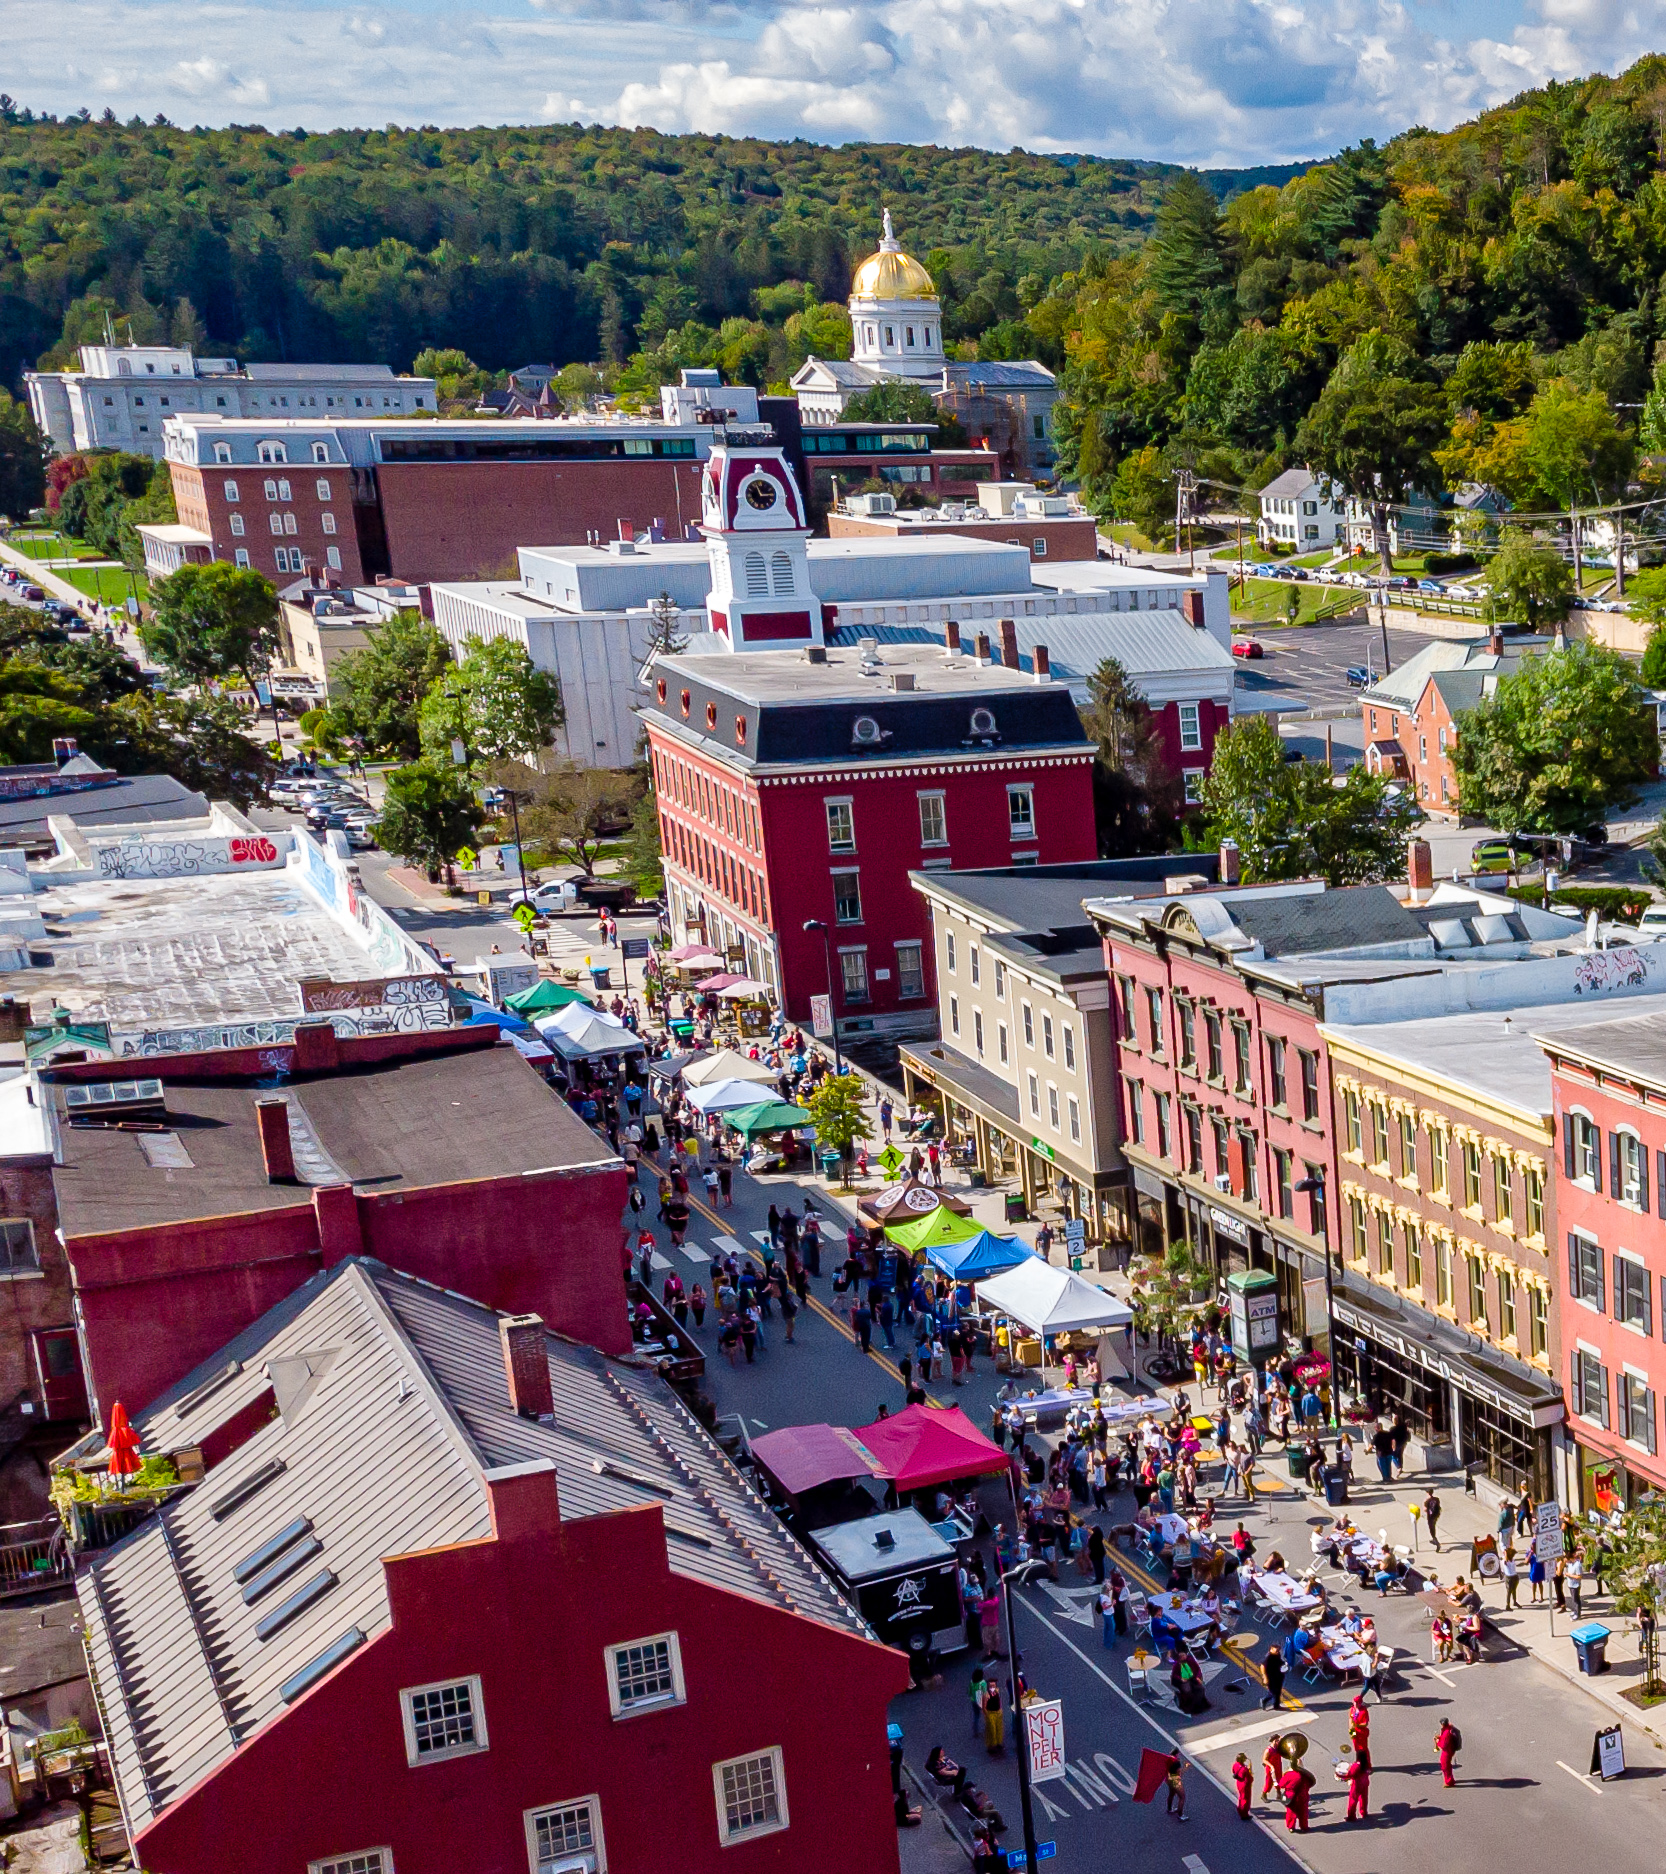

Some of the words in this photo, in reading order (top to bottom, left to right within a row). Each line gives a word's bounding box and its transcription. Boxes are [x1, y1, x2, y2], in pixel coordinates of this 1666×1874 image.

[1072, 1242, 1080, 1252] 2
[1250, 1305, 1275, 1317] ATM
[1541, 1516, 1558, 1530] 25
[1029, 1708, 1060, 1727] MO
[1031, 1722, 1060, 1742] NT
[1032, 1737, 1062, 1757] PEL
[1034, 1752, 1062, 1771] IER
